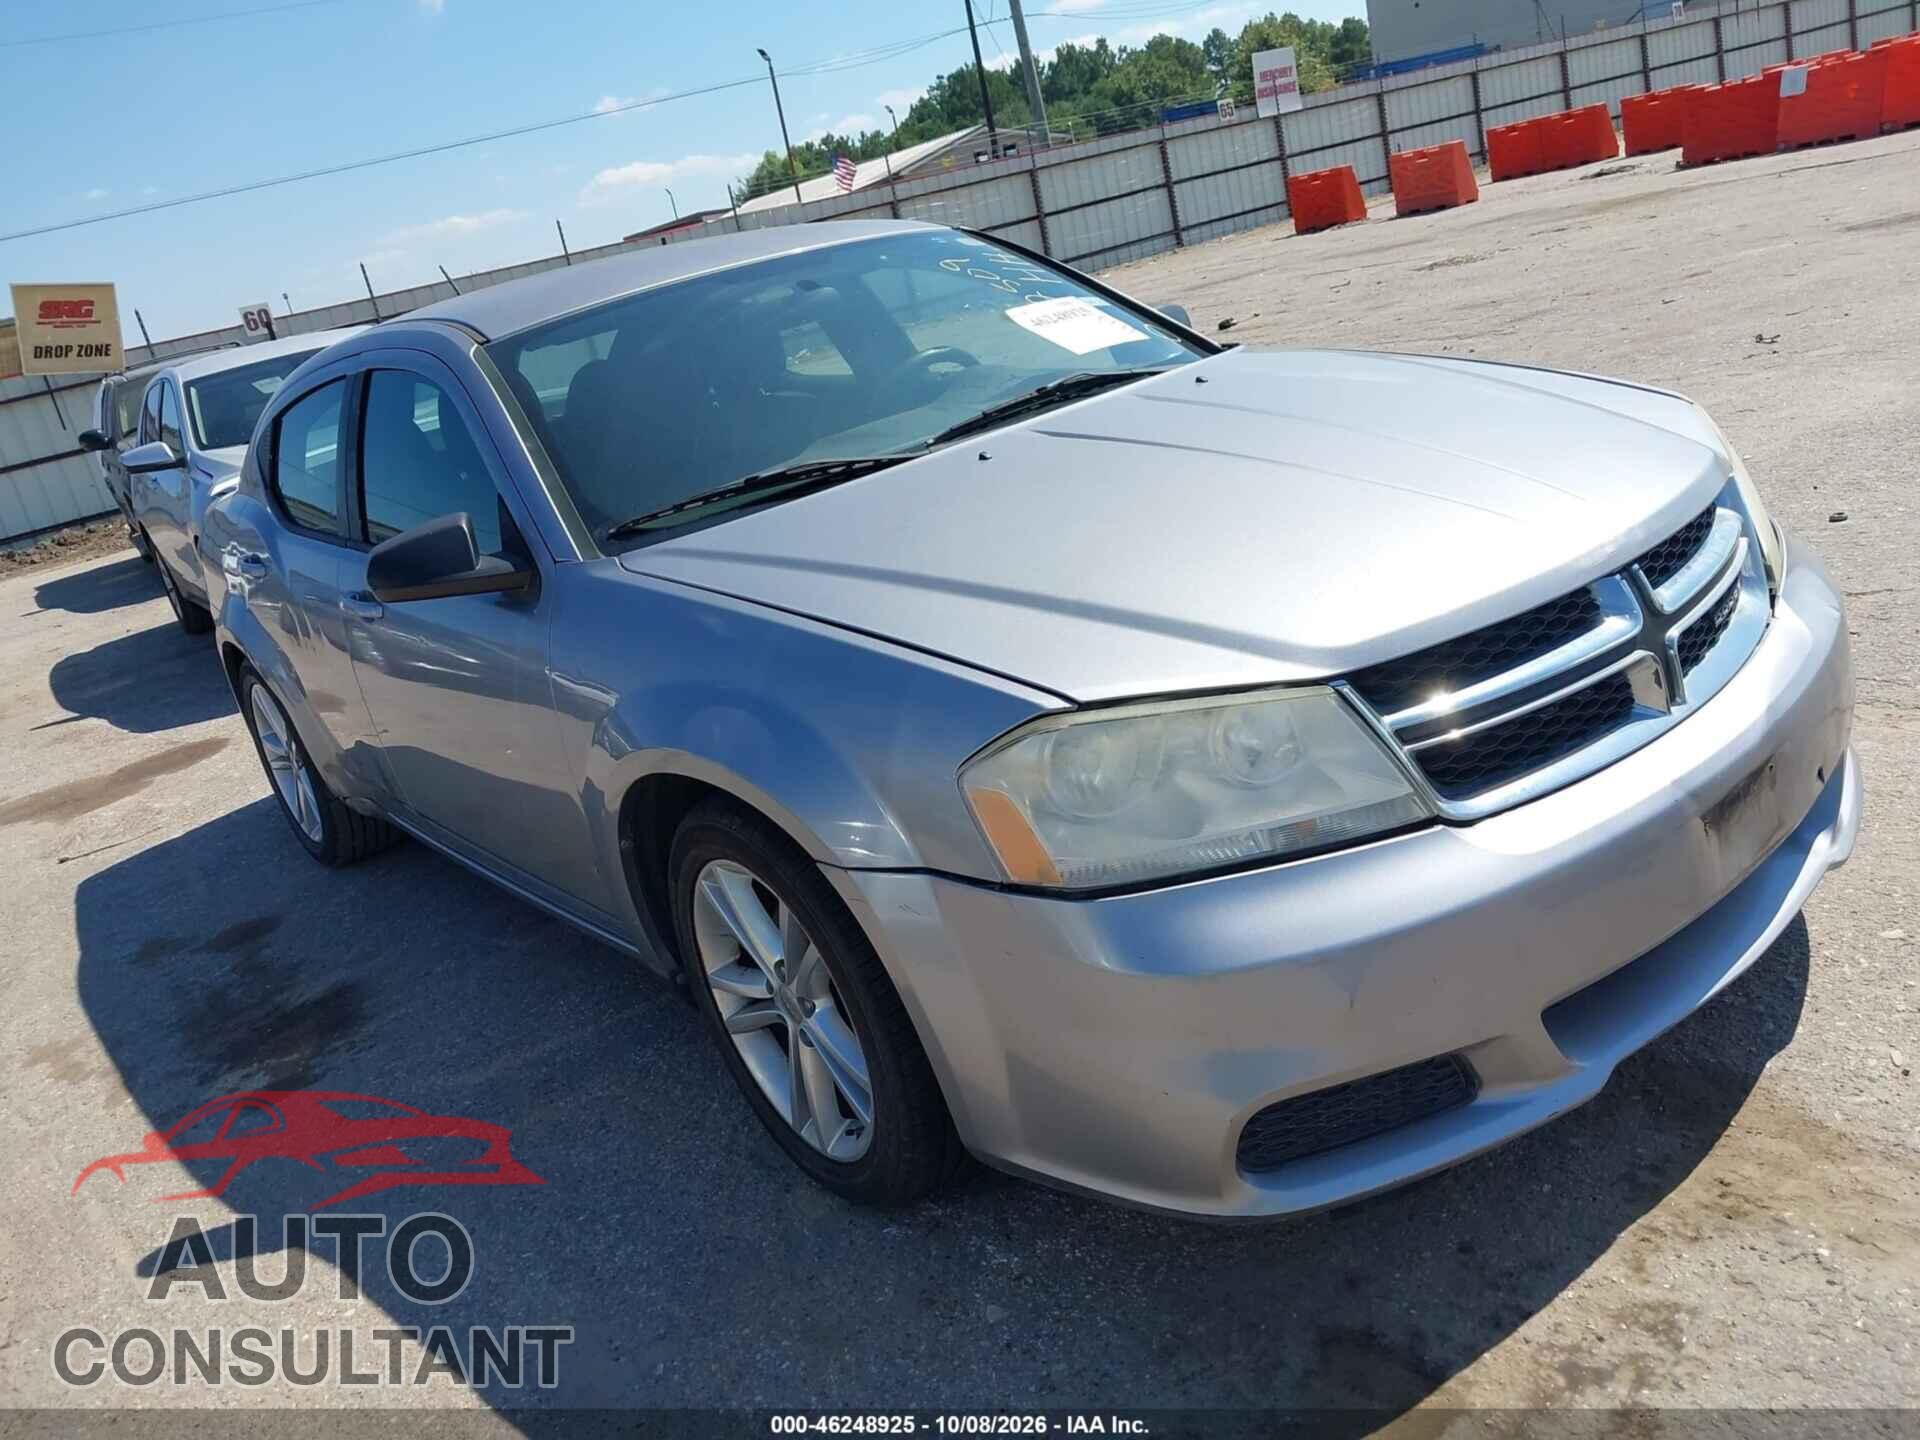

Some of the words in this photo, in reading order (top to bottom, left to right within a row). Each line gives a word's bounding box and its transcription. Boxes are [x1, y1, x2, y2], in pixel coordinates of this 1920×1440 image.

[243, 308, 271, 331] 60
[33, 344, 74, 359] DROP
[76, 343, 112, 359] ZONE
